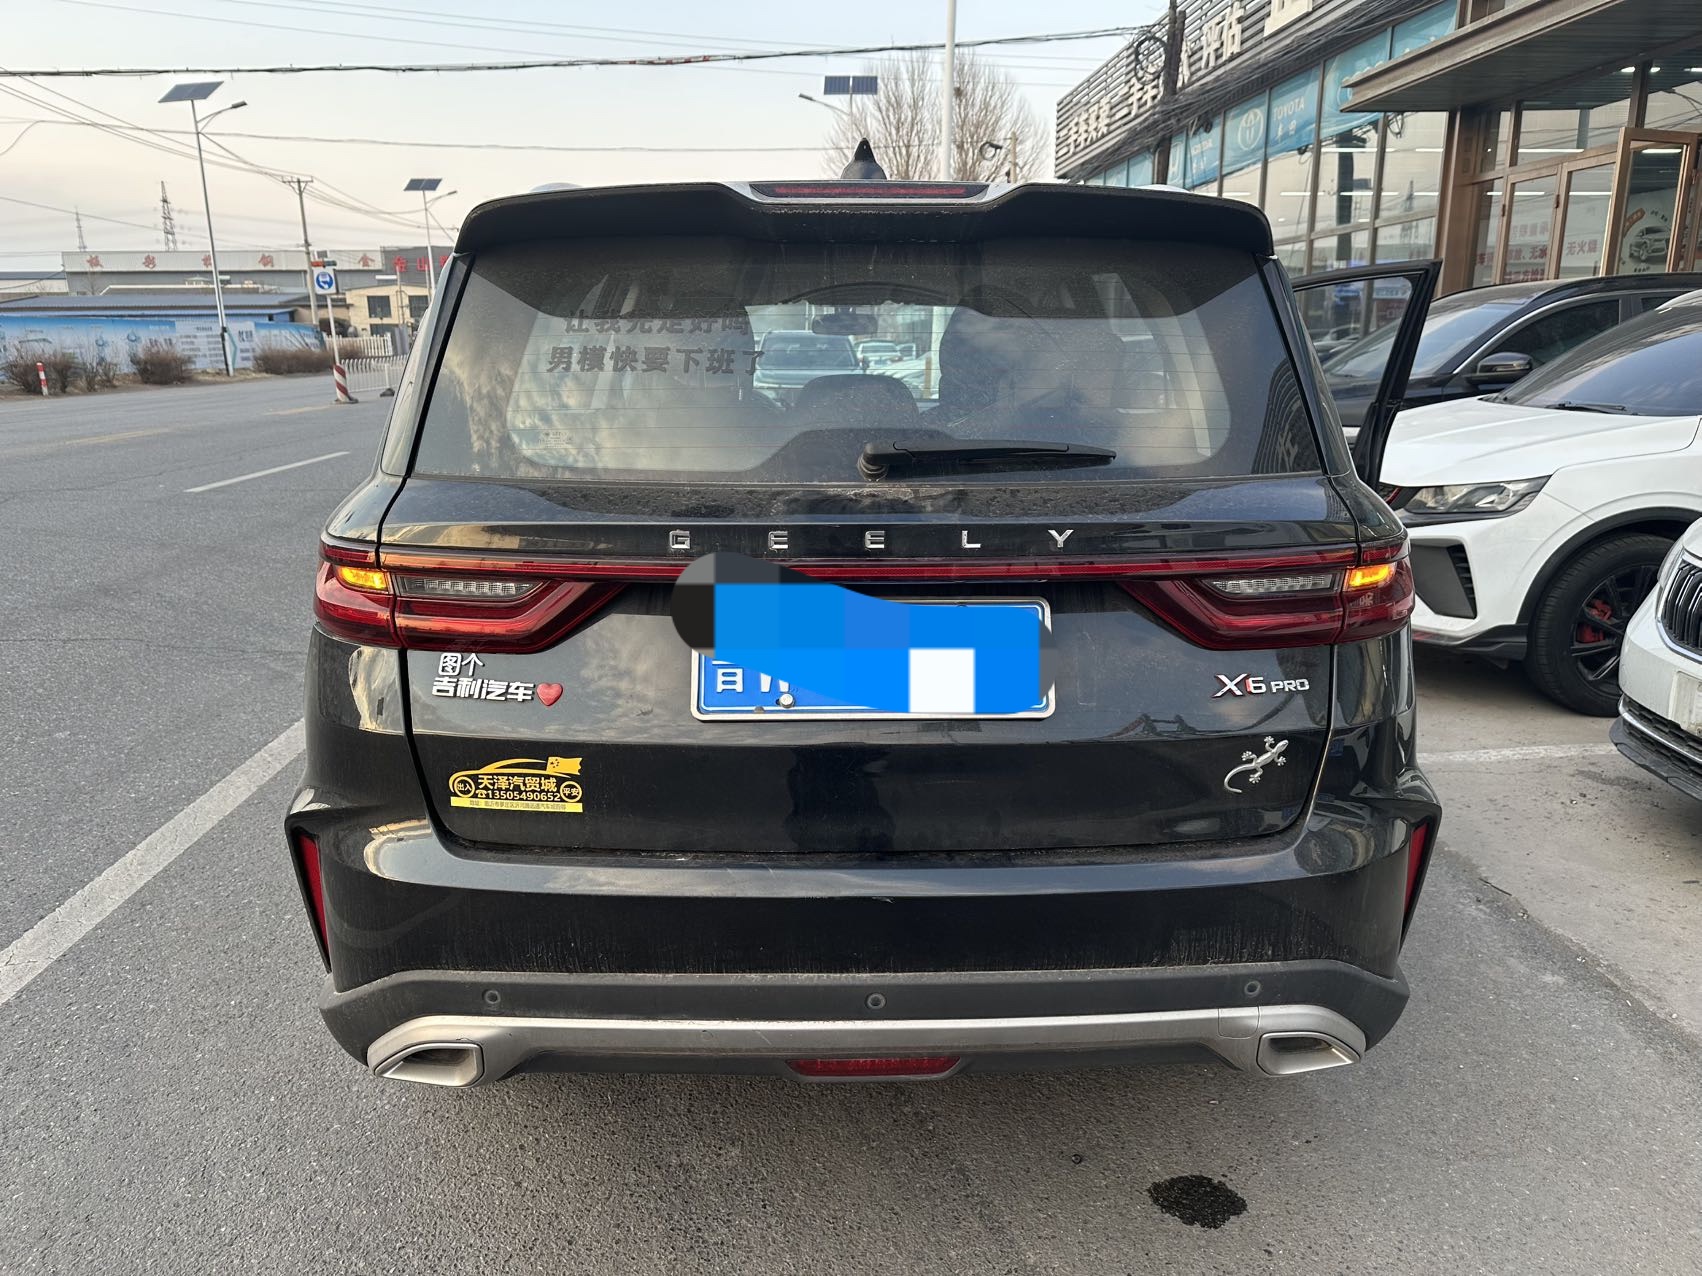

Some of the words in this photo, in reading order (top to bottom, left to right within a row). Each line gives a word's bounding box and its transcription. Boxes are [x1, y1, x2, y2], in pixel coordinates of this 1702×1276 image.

[1273, 97, 1305, 121] TOYOTA
[546, 345, 765, 376] 男模快要下班了
[669, 529, 1075, 551] GEELY
[438, 652, 484, 677] 图个
[431, 676, 536, 702] 吉利汽车
[1212, 673, 1267, 698] X6
[1270, 678, 1310, 693] PRO
[456, 782, 472, 793] 出入
[562, 786, 579, 797] 平安
[477, 774, 558, 792] 天泽汽贸城
[487, 789, 562, 802] 13505490652
